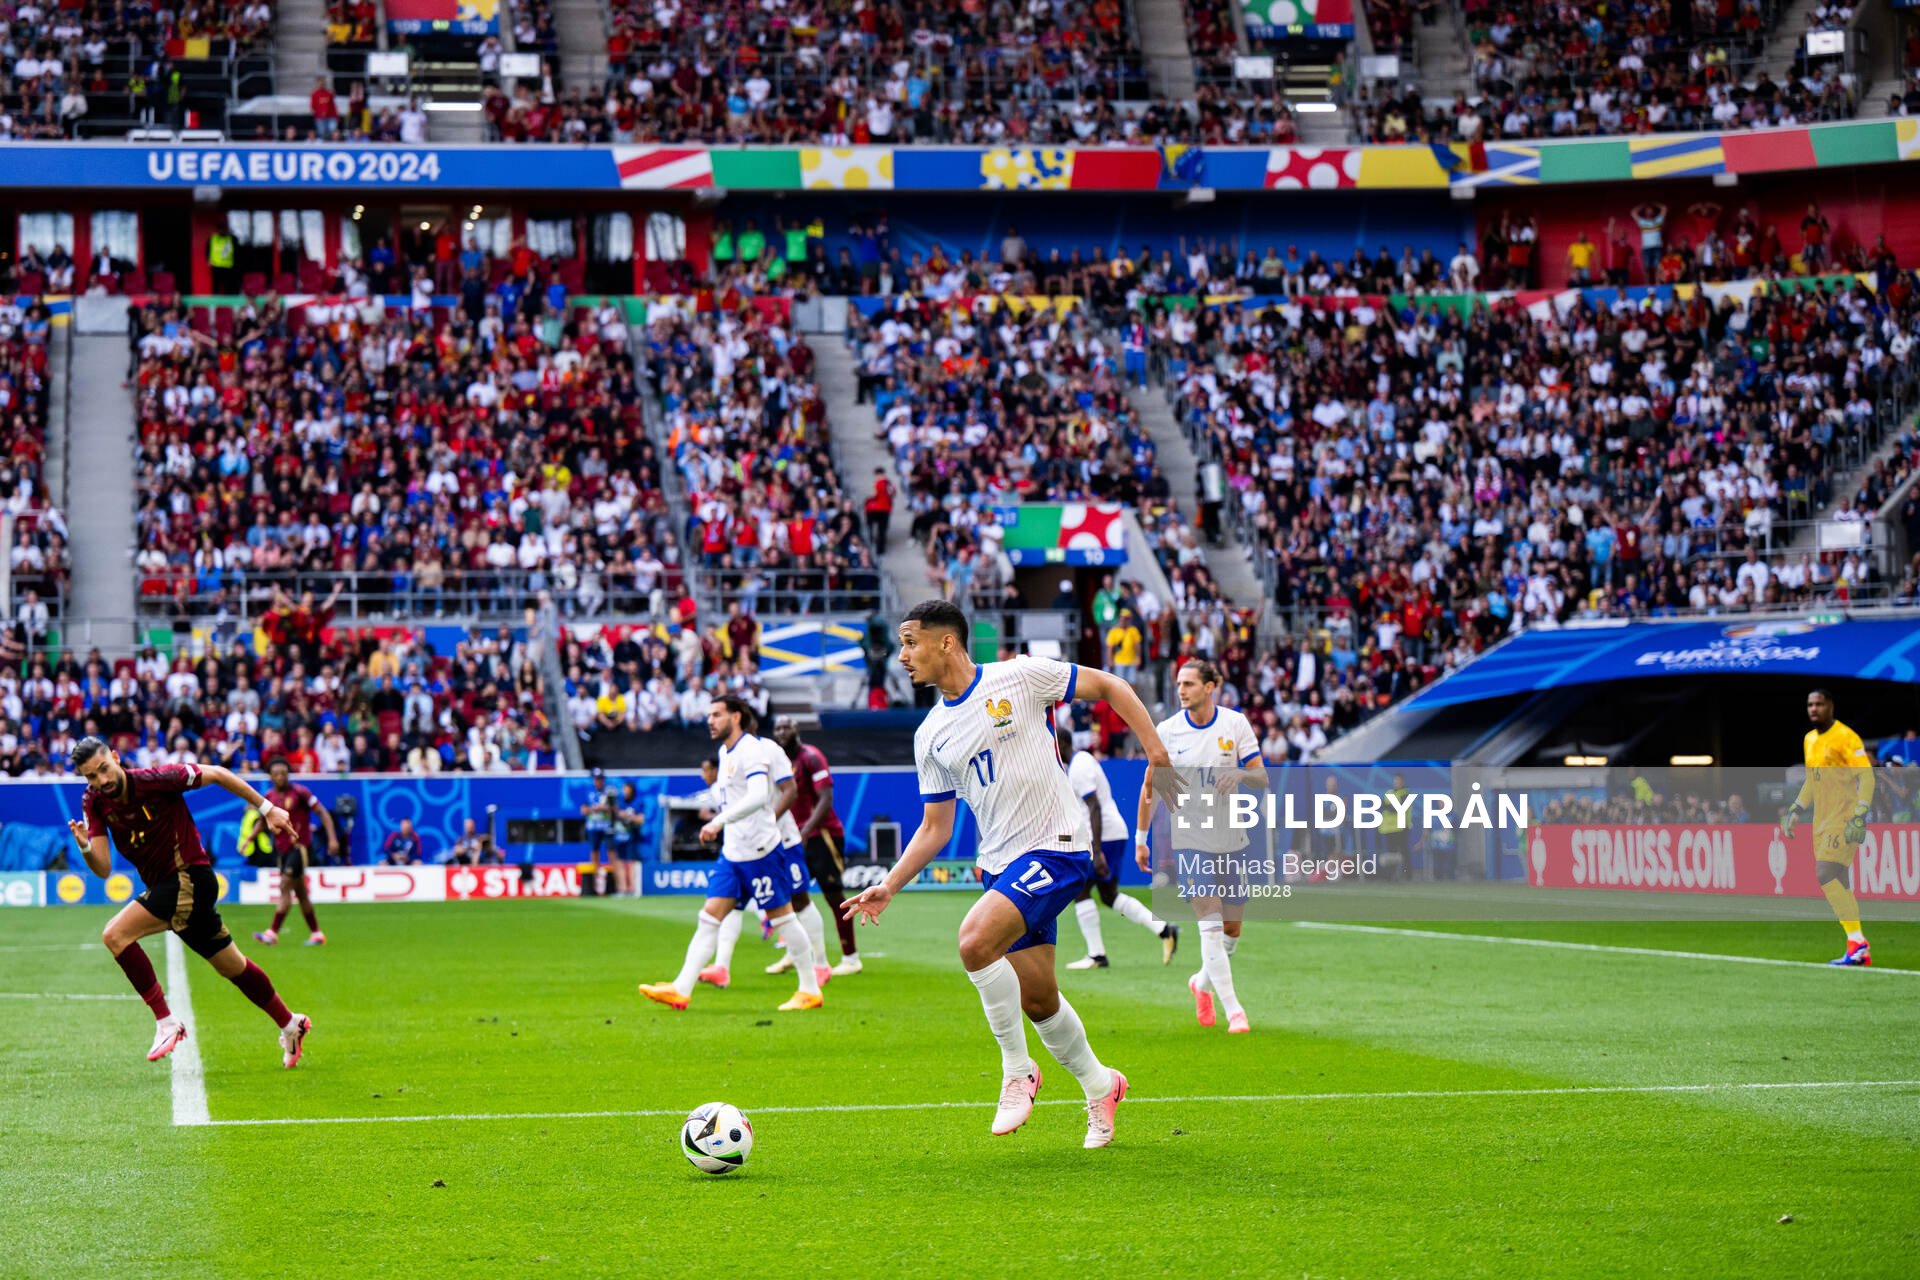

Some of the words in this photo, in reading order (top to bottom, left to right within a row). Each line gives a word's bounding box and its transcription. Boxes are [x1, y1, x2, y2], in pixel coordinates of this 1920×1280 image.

[968, 748, 996, 788] 17
[1197, 766, 1216, 788] 14
[1571, 829, 1736, 889] STRAUSS.COM
[752, 876, 774, 898] 22
[1019, 860, 1054, 892] 17
